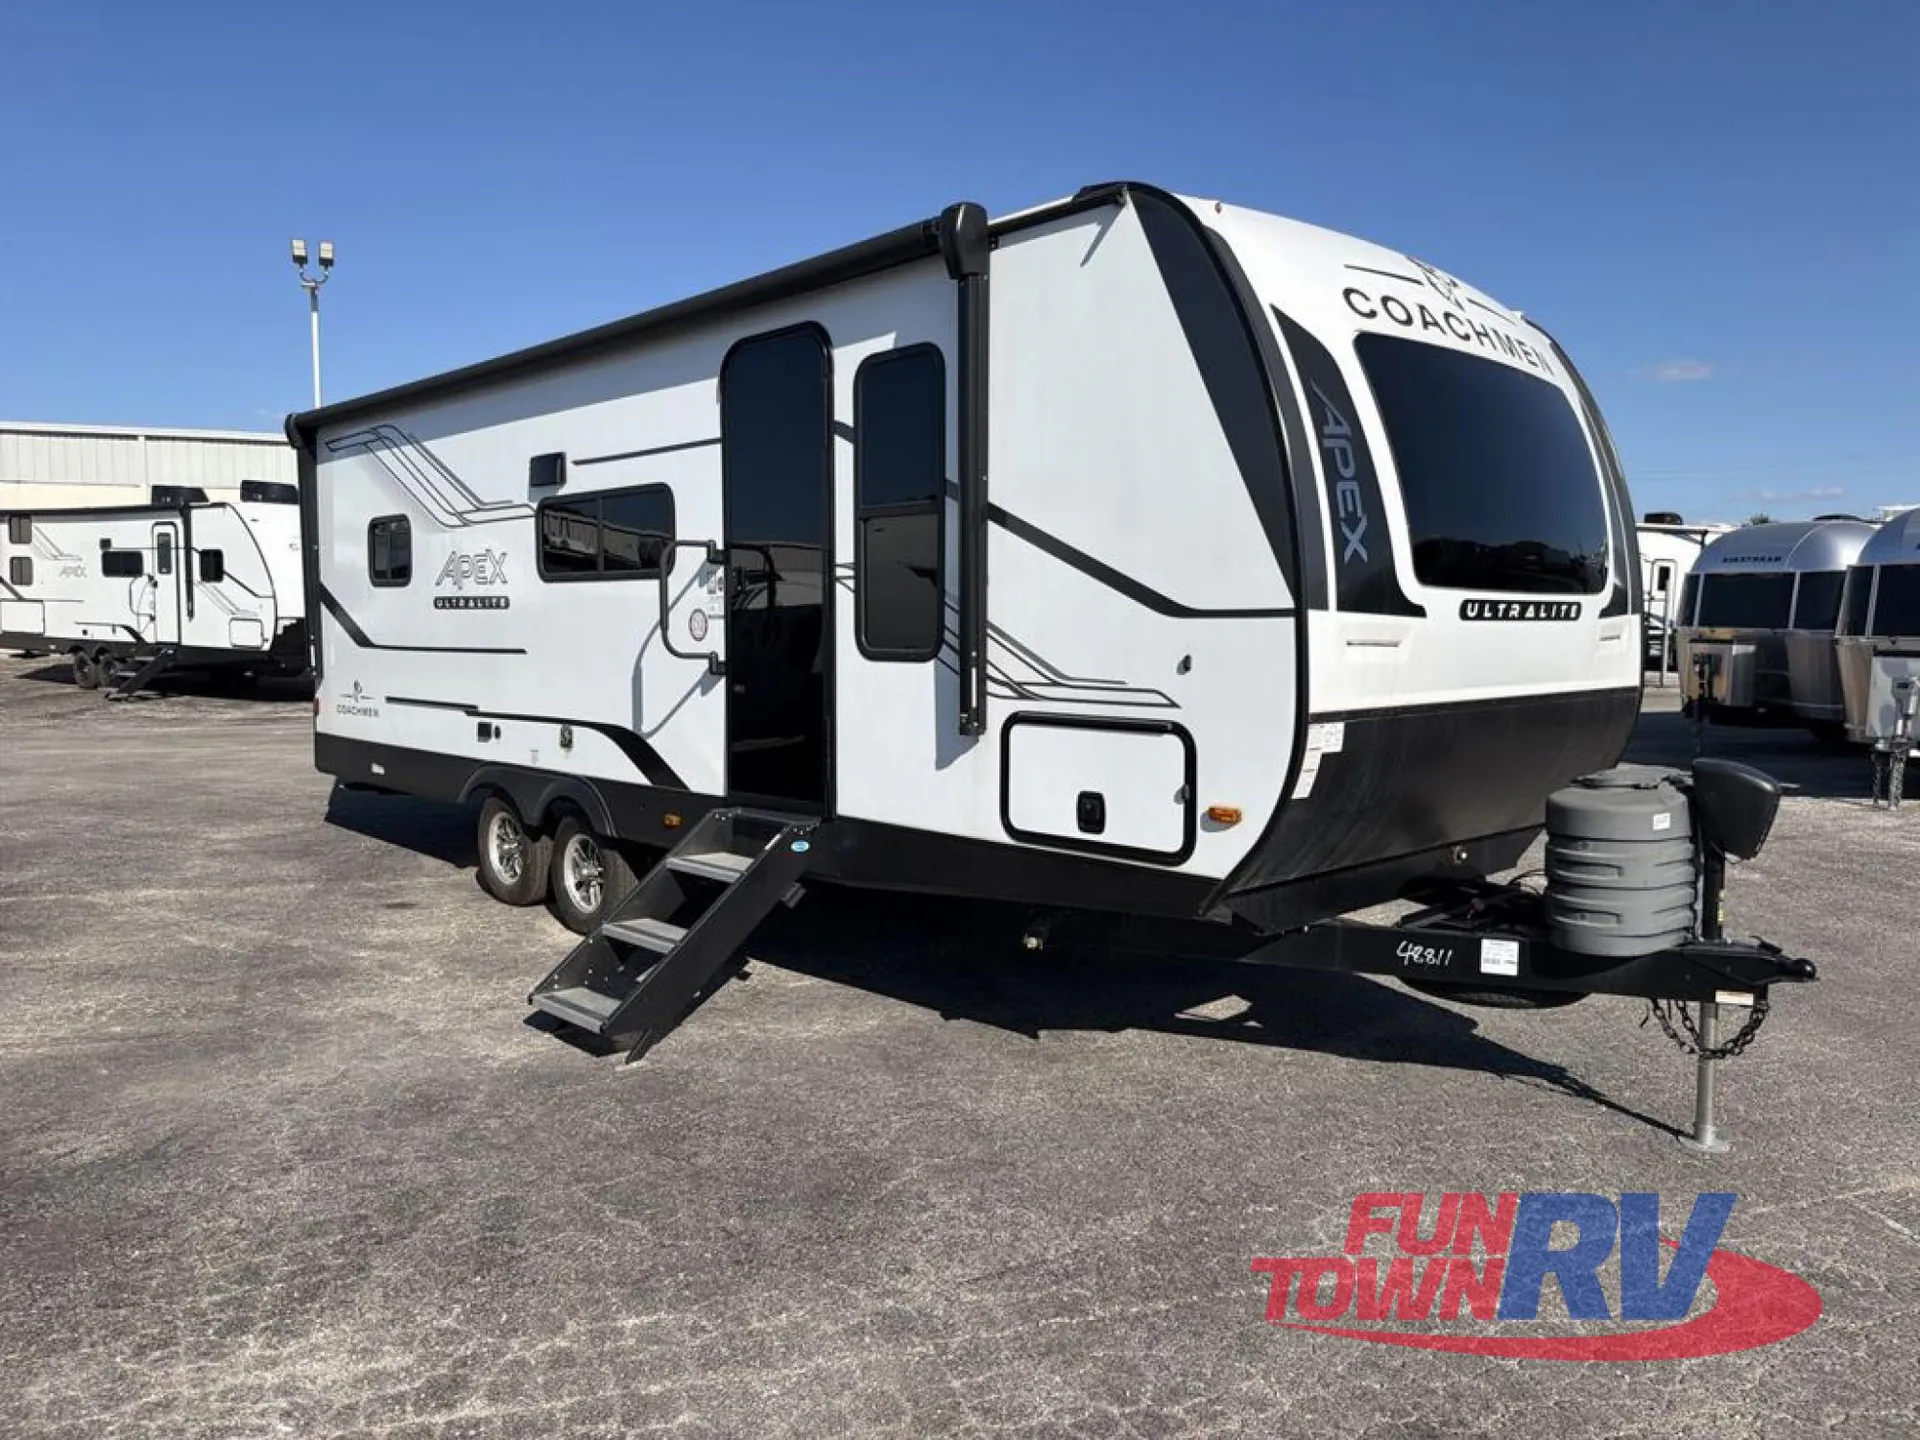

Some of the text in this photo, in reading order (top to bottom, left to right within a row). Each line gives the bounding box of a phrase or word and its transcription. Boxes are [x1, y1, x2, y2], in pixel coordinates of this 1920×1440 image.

[1342, 287, 1555, 376] COACHMEN
[1310, 377, 1369, 565] APEX
[435, 548, 508, 590] APEX
[1466, 601, 1578, 618] ULTRALITE
[1396, 940, 1453, 966] 48811
